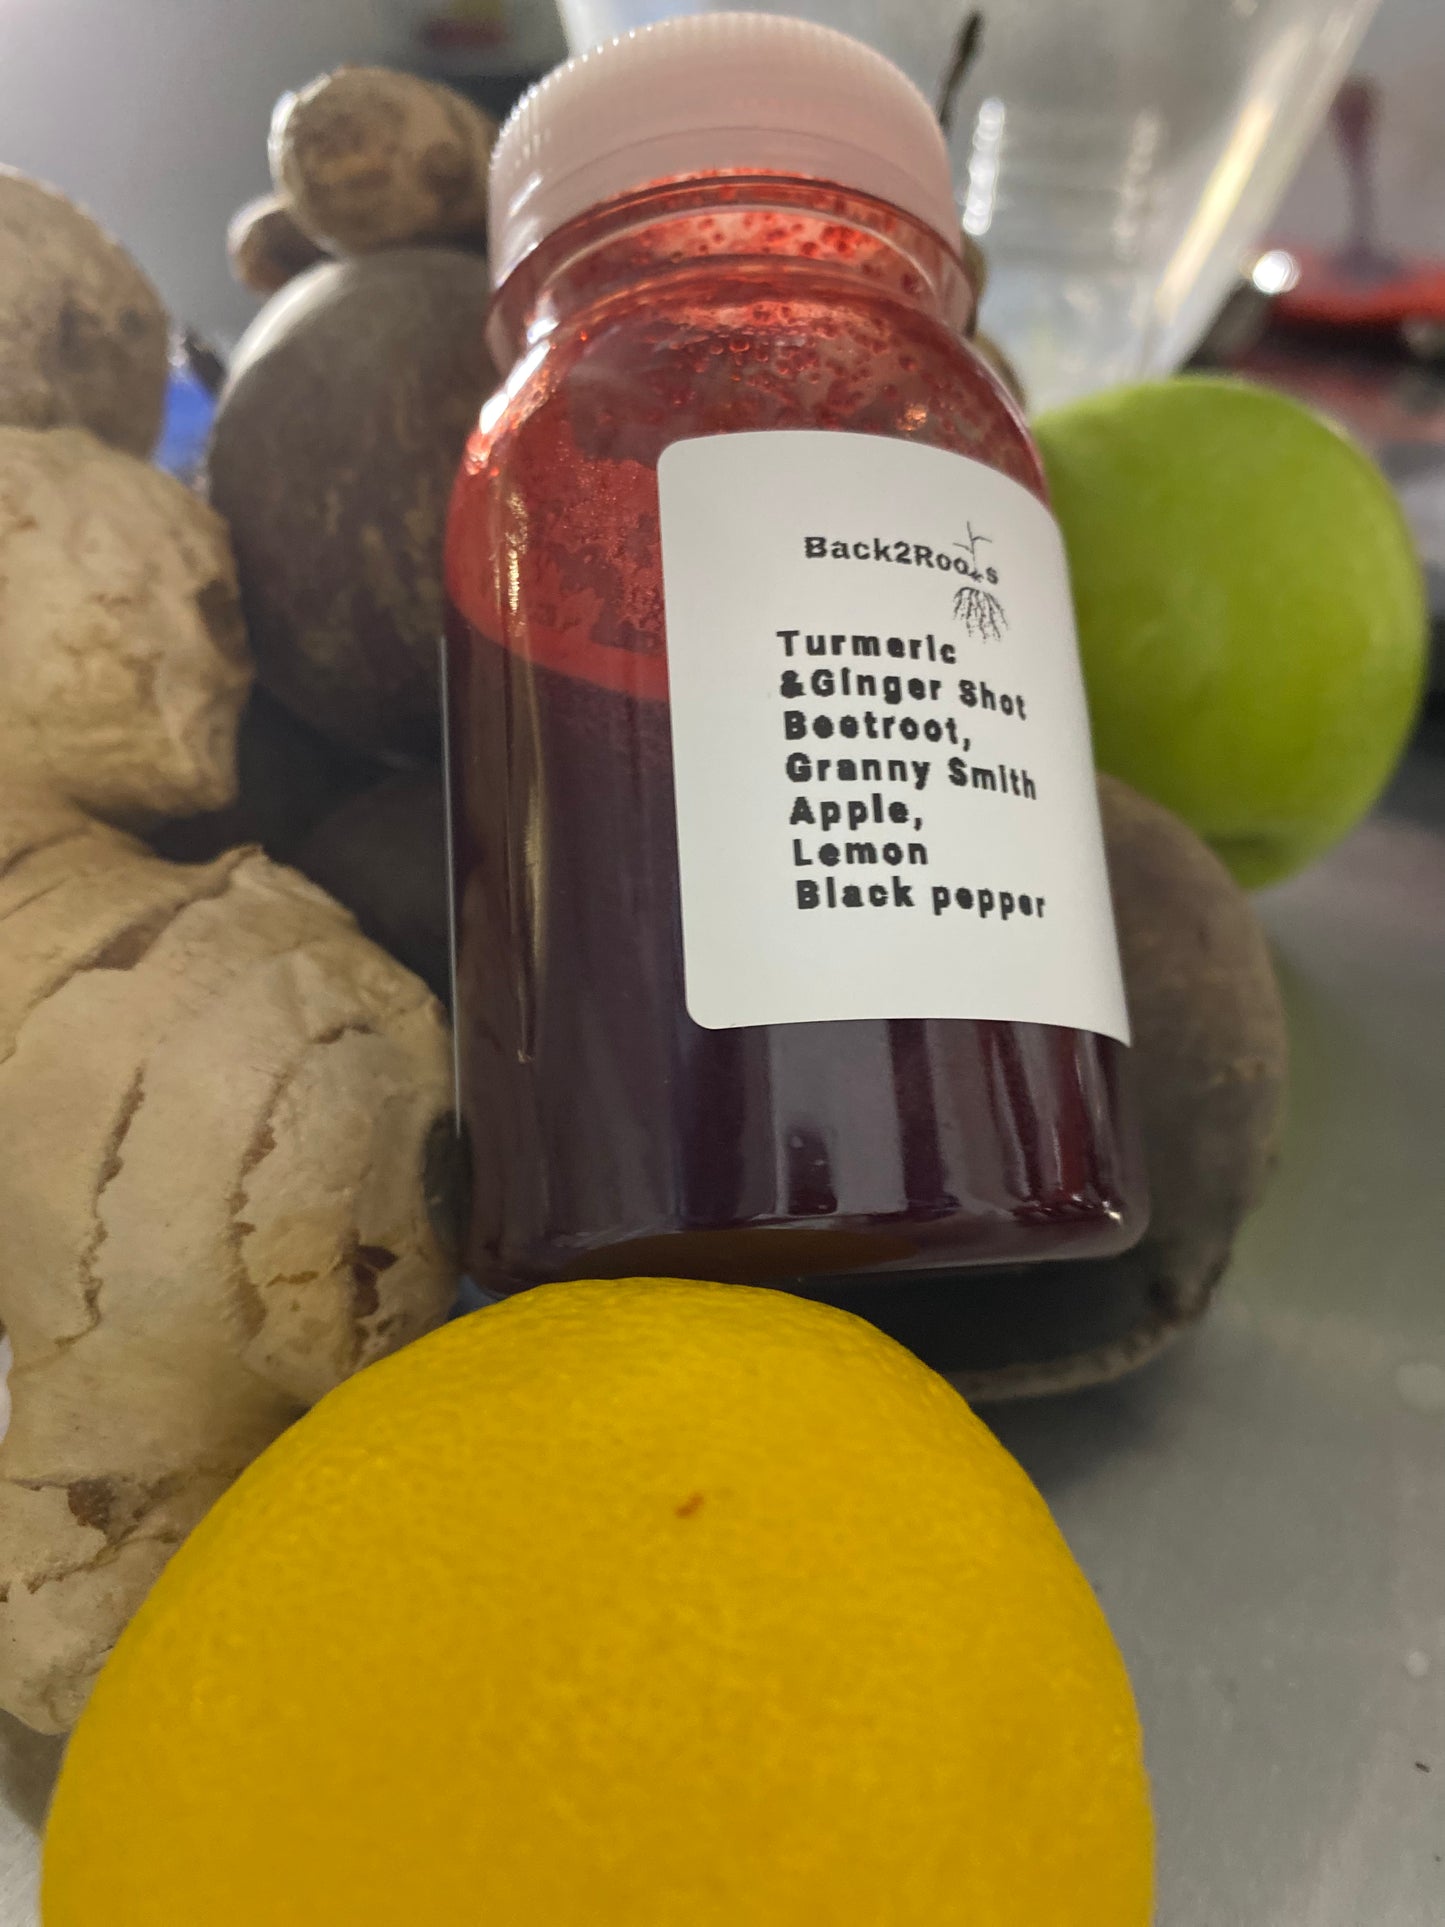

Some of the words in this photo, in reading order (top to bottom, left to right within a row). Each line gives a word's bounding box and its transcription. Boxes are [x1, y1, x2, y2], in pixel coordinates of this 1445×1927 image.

[776, 629, 957, 665] Turmeric
[780, 667, 942, 705] &Ginger
[958, 679, 1026, 721] Shot
[783, 710, 971, 753] Beetroot,
[785, 751, 931, 791] Granny
[947, 756, 1037, 801] Smith
[789, 793, 923, 832] Apple,
[792, 838, 928, 867] Lemon
[796, 876, 915, 910] Black
[931, 885, 1045, 921] pepper
